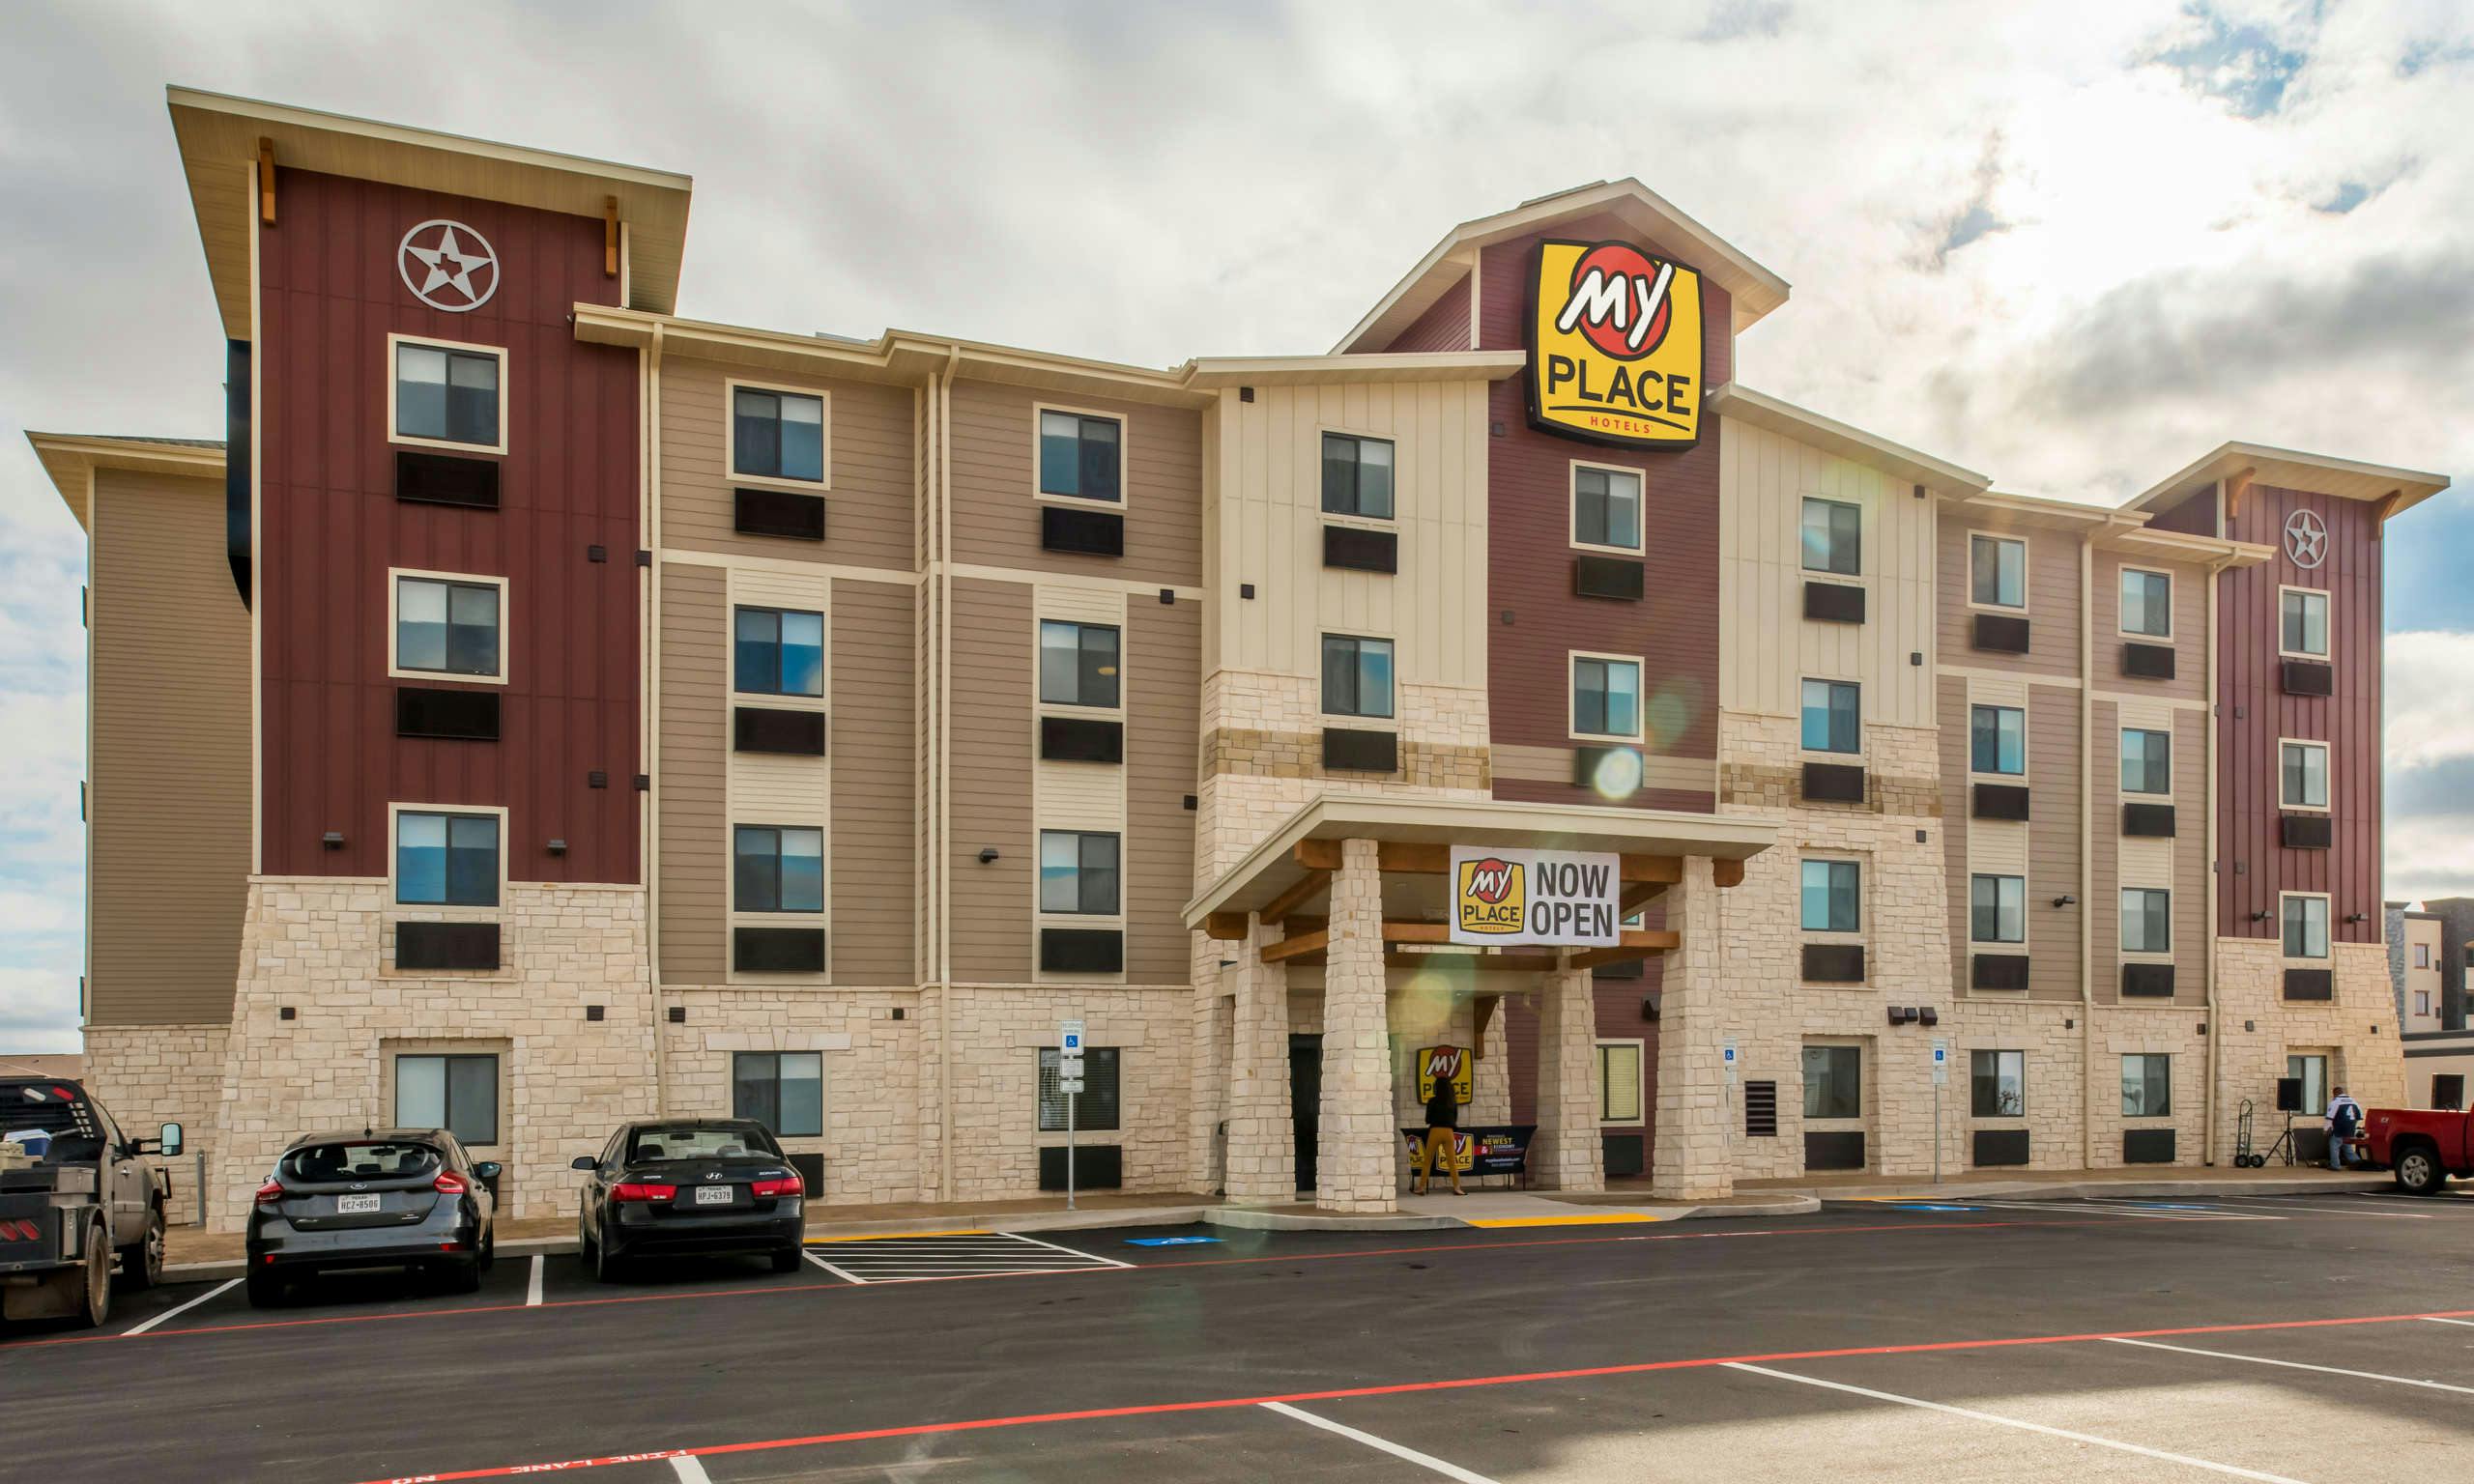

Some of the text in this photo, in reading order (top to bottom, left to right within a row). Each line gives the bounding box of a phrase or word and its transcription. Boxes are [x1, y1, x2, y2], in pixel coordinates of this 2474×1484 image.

[1548, 354, 1690, 415] PLACE
[1590, 416, 1651, 433] HOTELS
[1537, 862, 1610, 899] NOW
[1463, 904, 1520, 922] PLACE
[1531, 901, 1613, 937] OPEN
